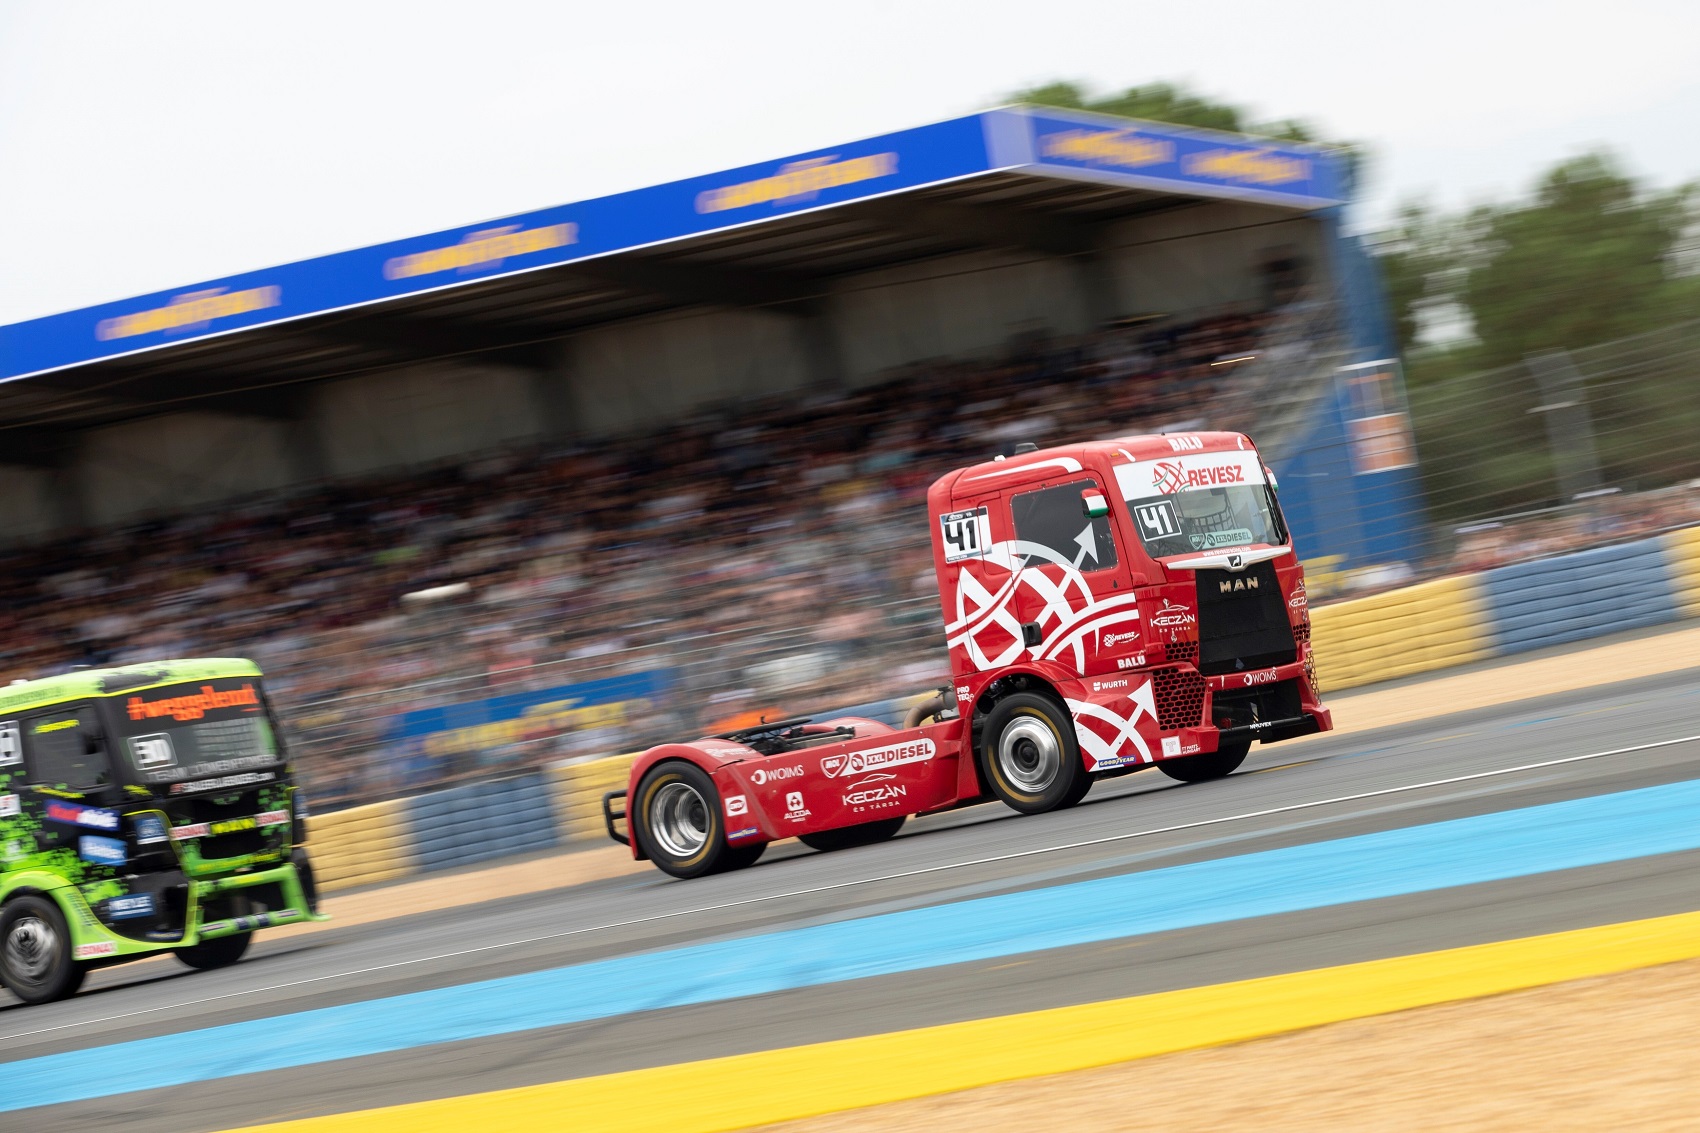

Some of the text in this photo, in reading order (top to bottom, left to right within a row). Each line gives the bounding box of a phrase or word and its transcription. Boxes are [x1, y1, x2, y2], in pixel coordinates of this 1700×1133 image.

[1167, 435, 1204, 452] BALU
[1187, 465, 1244, 487] REVESZ
[1140, 505, 1174, 535] 41
[944, 519, 977, 551] 41
[1227, 531, 1251, 542] DIESEL
[1219, 577, 1259, 593] MAN
[868, 743, 932, 764] XXL DIESEL
[1099, 756, 1135, 767] GOODYEAR
